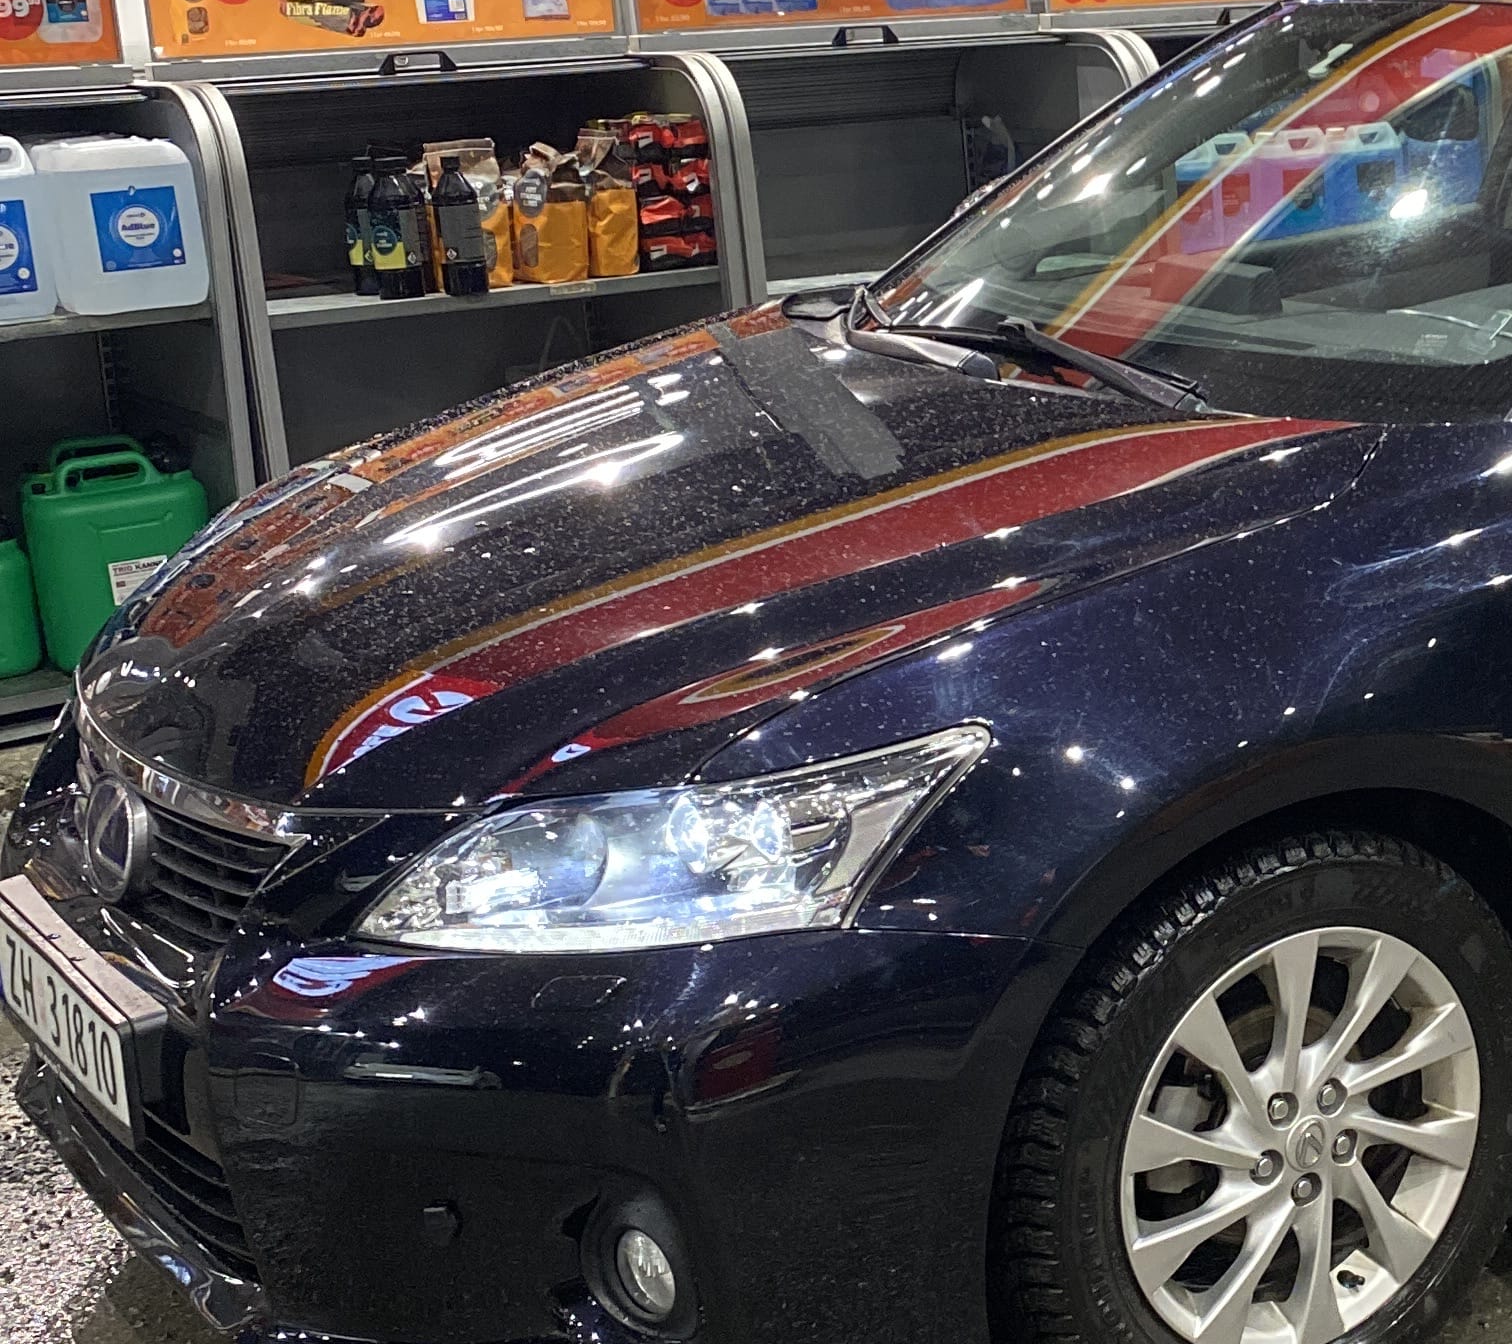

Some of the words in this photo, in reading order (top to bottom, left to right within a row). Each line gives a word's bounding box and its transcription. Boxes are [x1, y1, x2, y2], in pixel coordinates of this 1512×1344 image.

[286, 0, 313, 16] Fibra
[6, 934, 38, 1025] ZH
[47, 975, 118, 1106] 31810
